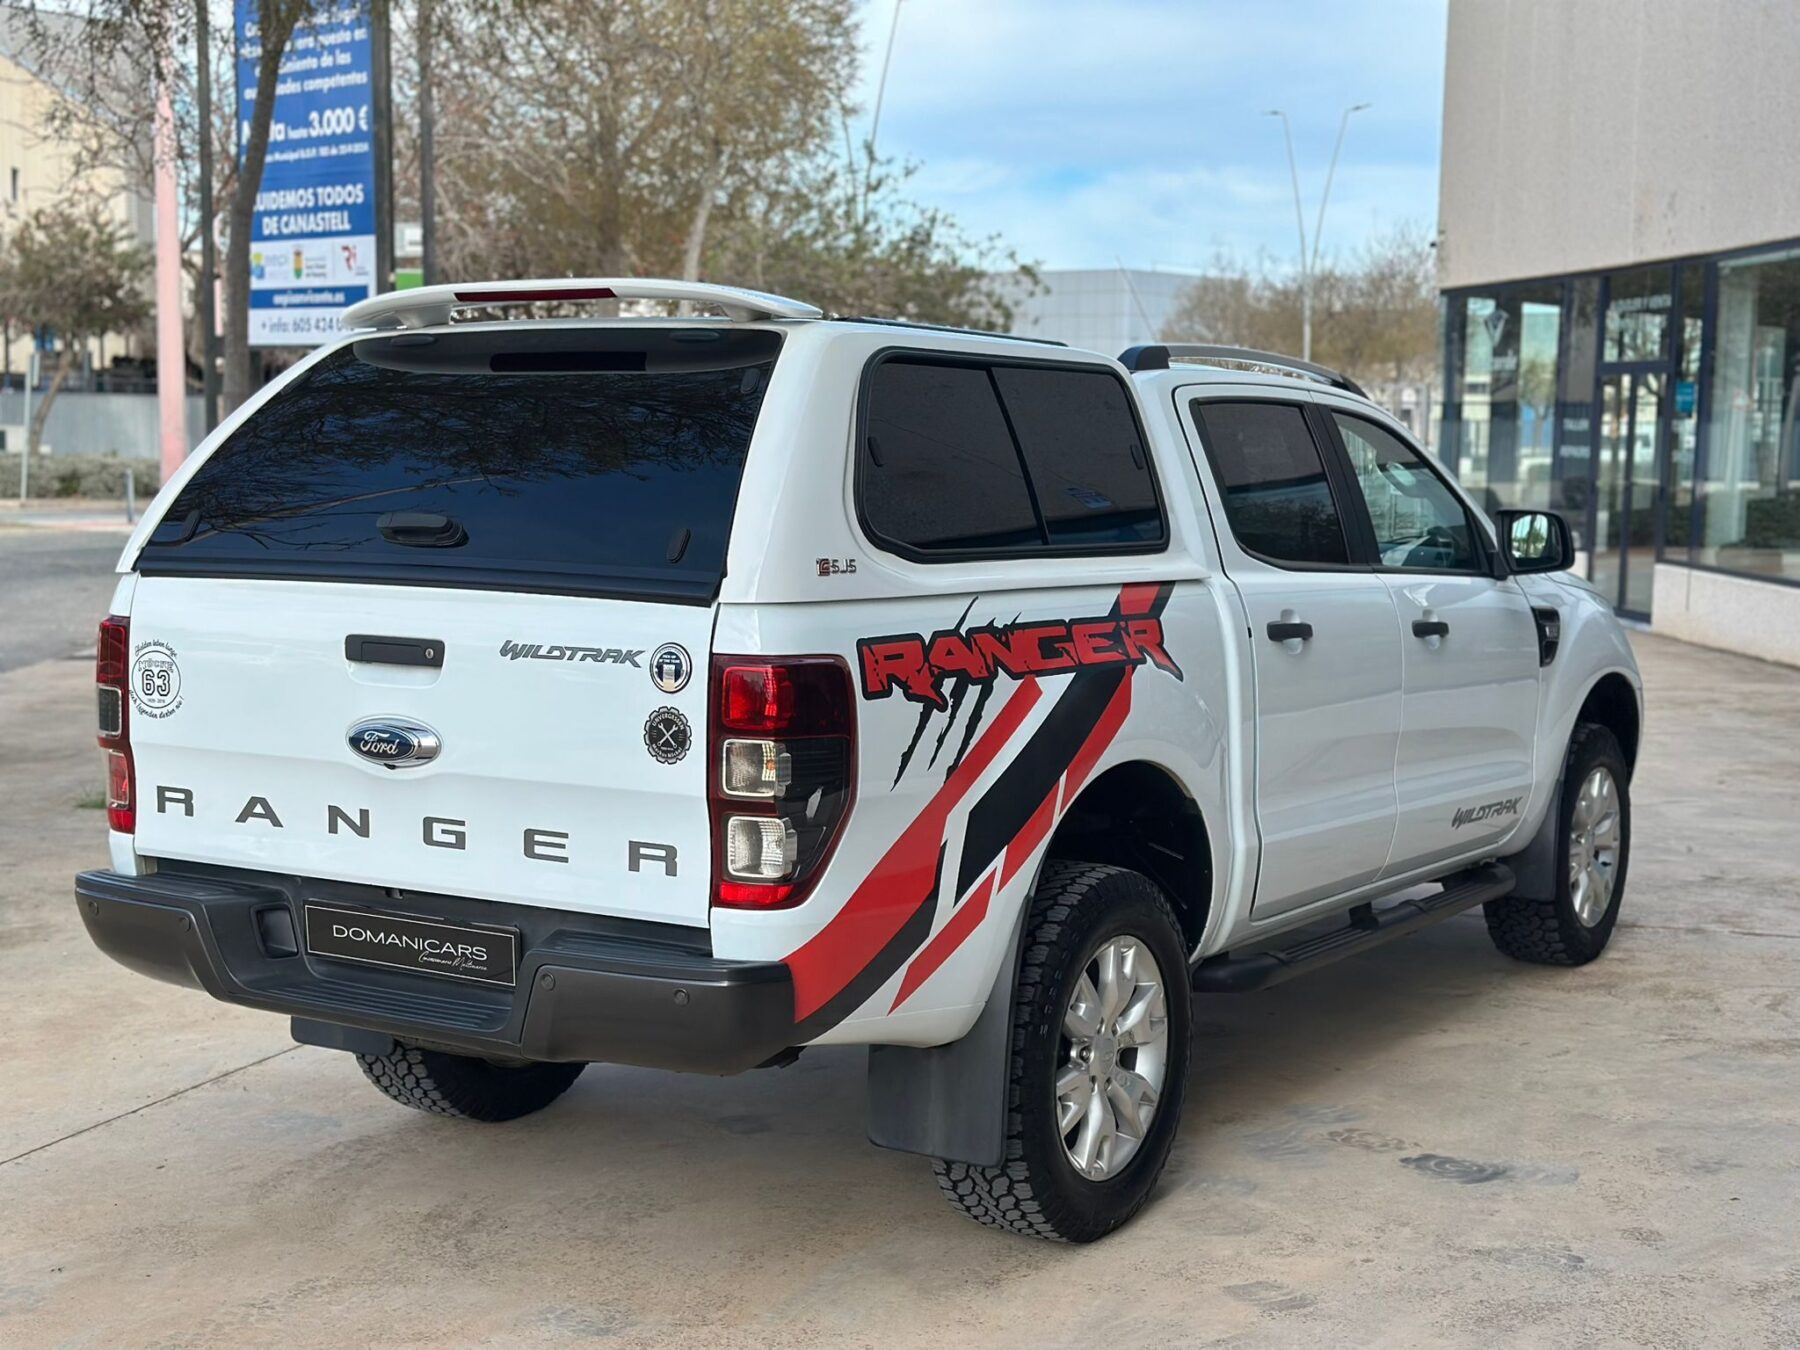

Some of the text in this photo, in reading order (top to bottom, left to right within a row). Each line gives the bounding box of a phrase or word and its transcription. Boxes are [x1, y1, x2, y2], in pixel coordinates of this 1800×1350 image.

[320, 50, 334, 68] de
[335, 48, 352, 65] las
[303, 71, 368, 94] competentes
[308, 106, 356, 138] 3.000
[358, 104, 369, 132] €
[252, 183, 365, 212] UIDEMOS TODOS
[262, 210, 352, 236] DE CANASTELL
[499, 639, 646, 669] WILDTRAK
[857, 616, 1184, 711] RANGER
[141, 668, 171, 697] 63
[360, 730, 400, 755] Ford
[1451, 796, 1523, 830] WILDTRAK
[156, 784, 678, 878] RANGER
[332, 924, 489, 961] DOMANICARS
